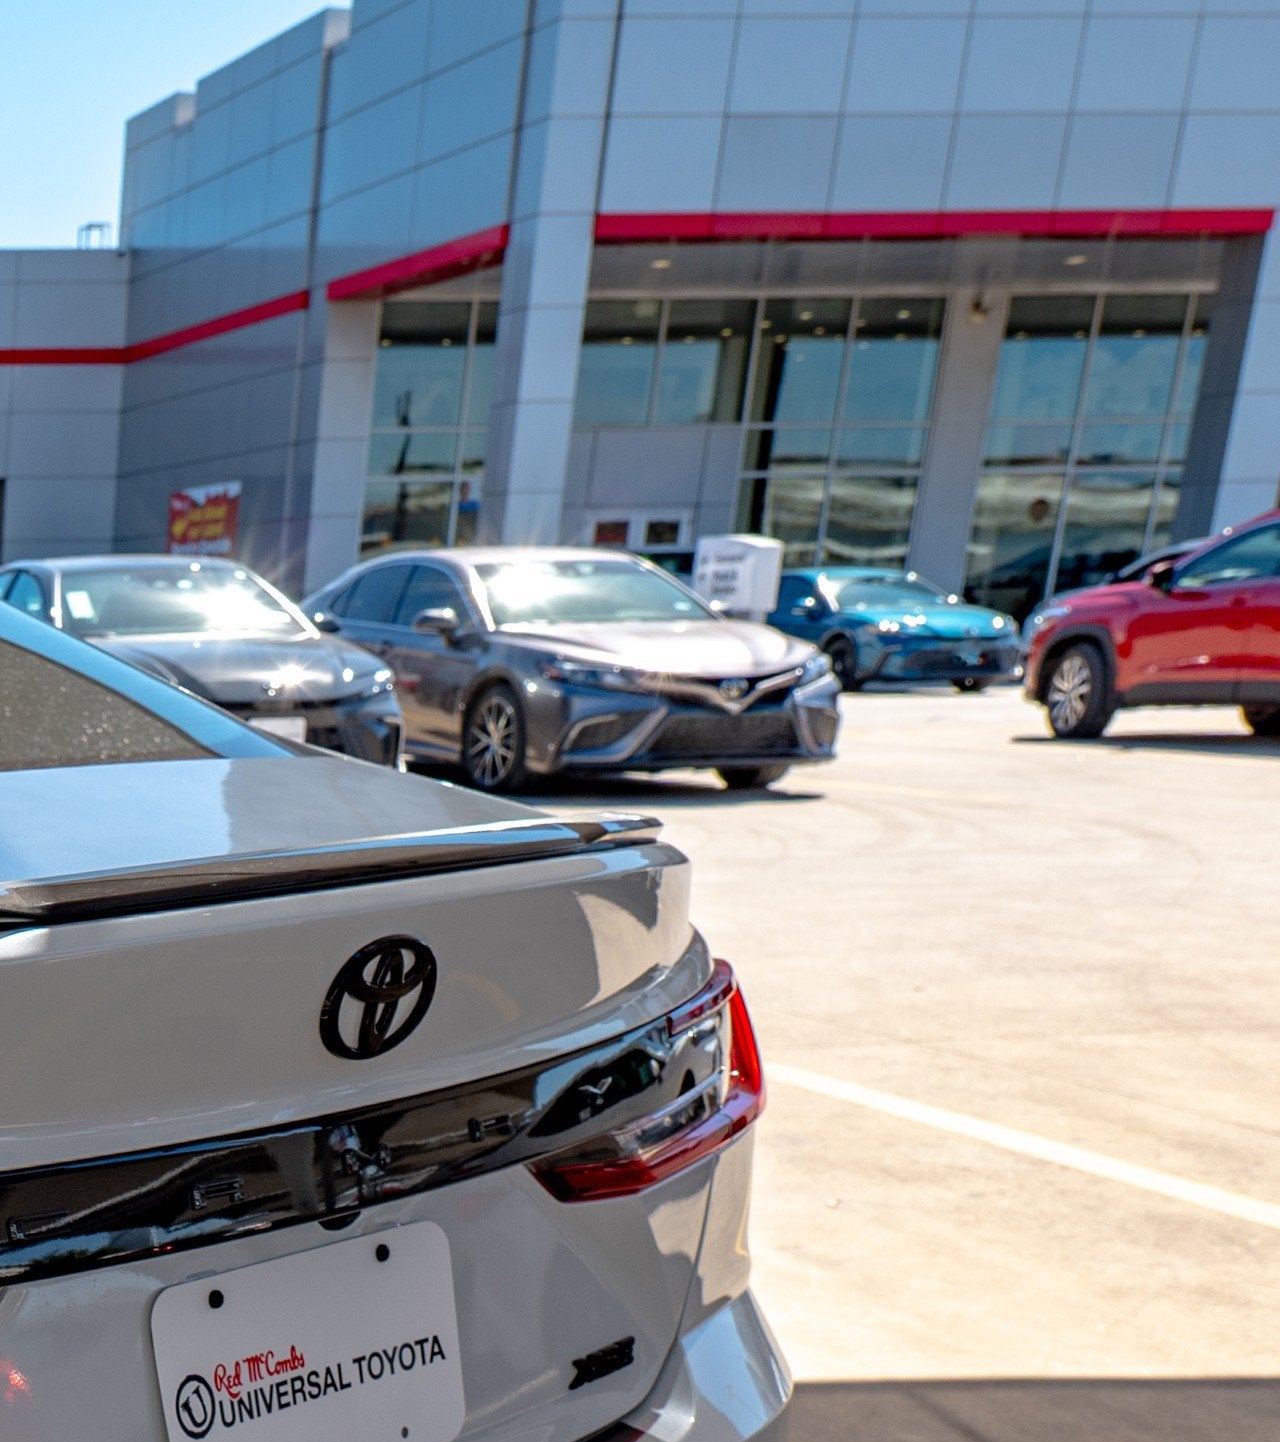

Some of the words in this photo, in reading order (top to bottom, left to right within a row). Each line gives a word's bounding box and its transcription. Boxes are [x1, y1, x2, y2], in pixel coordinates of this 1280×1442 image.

[213, 1359, 243, 1399] Red
[218, 1363, 352, 1428] UNIVERSAL
[352, 1335, 446, 1384] TOYOTA
